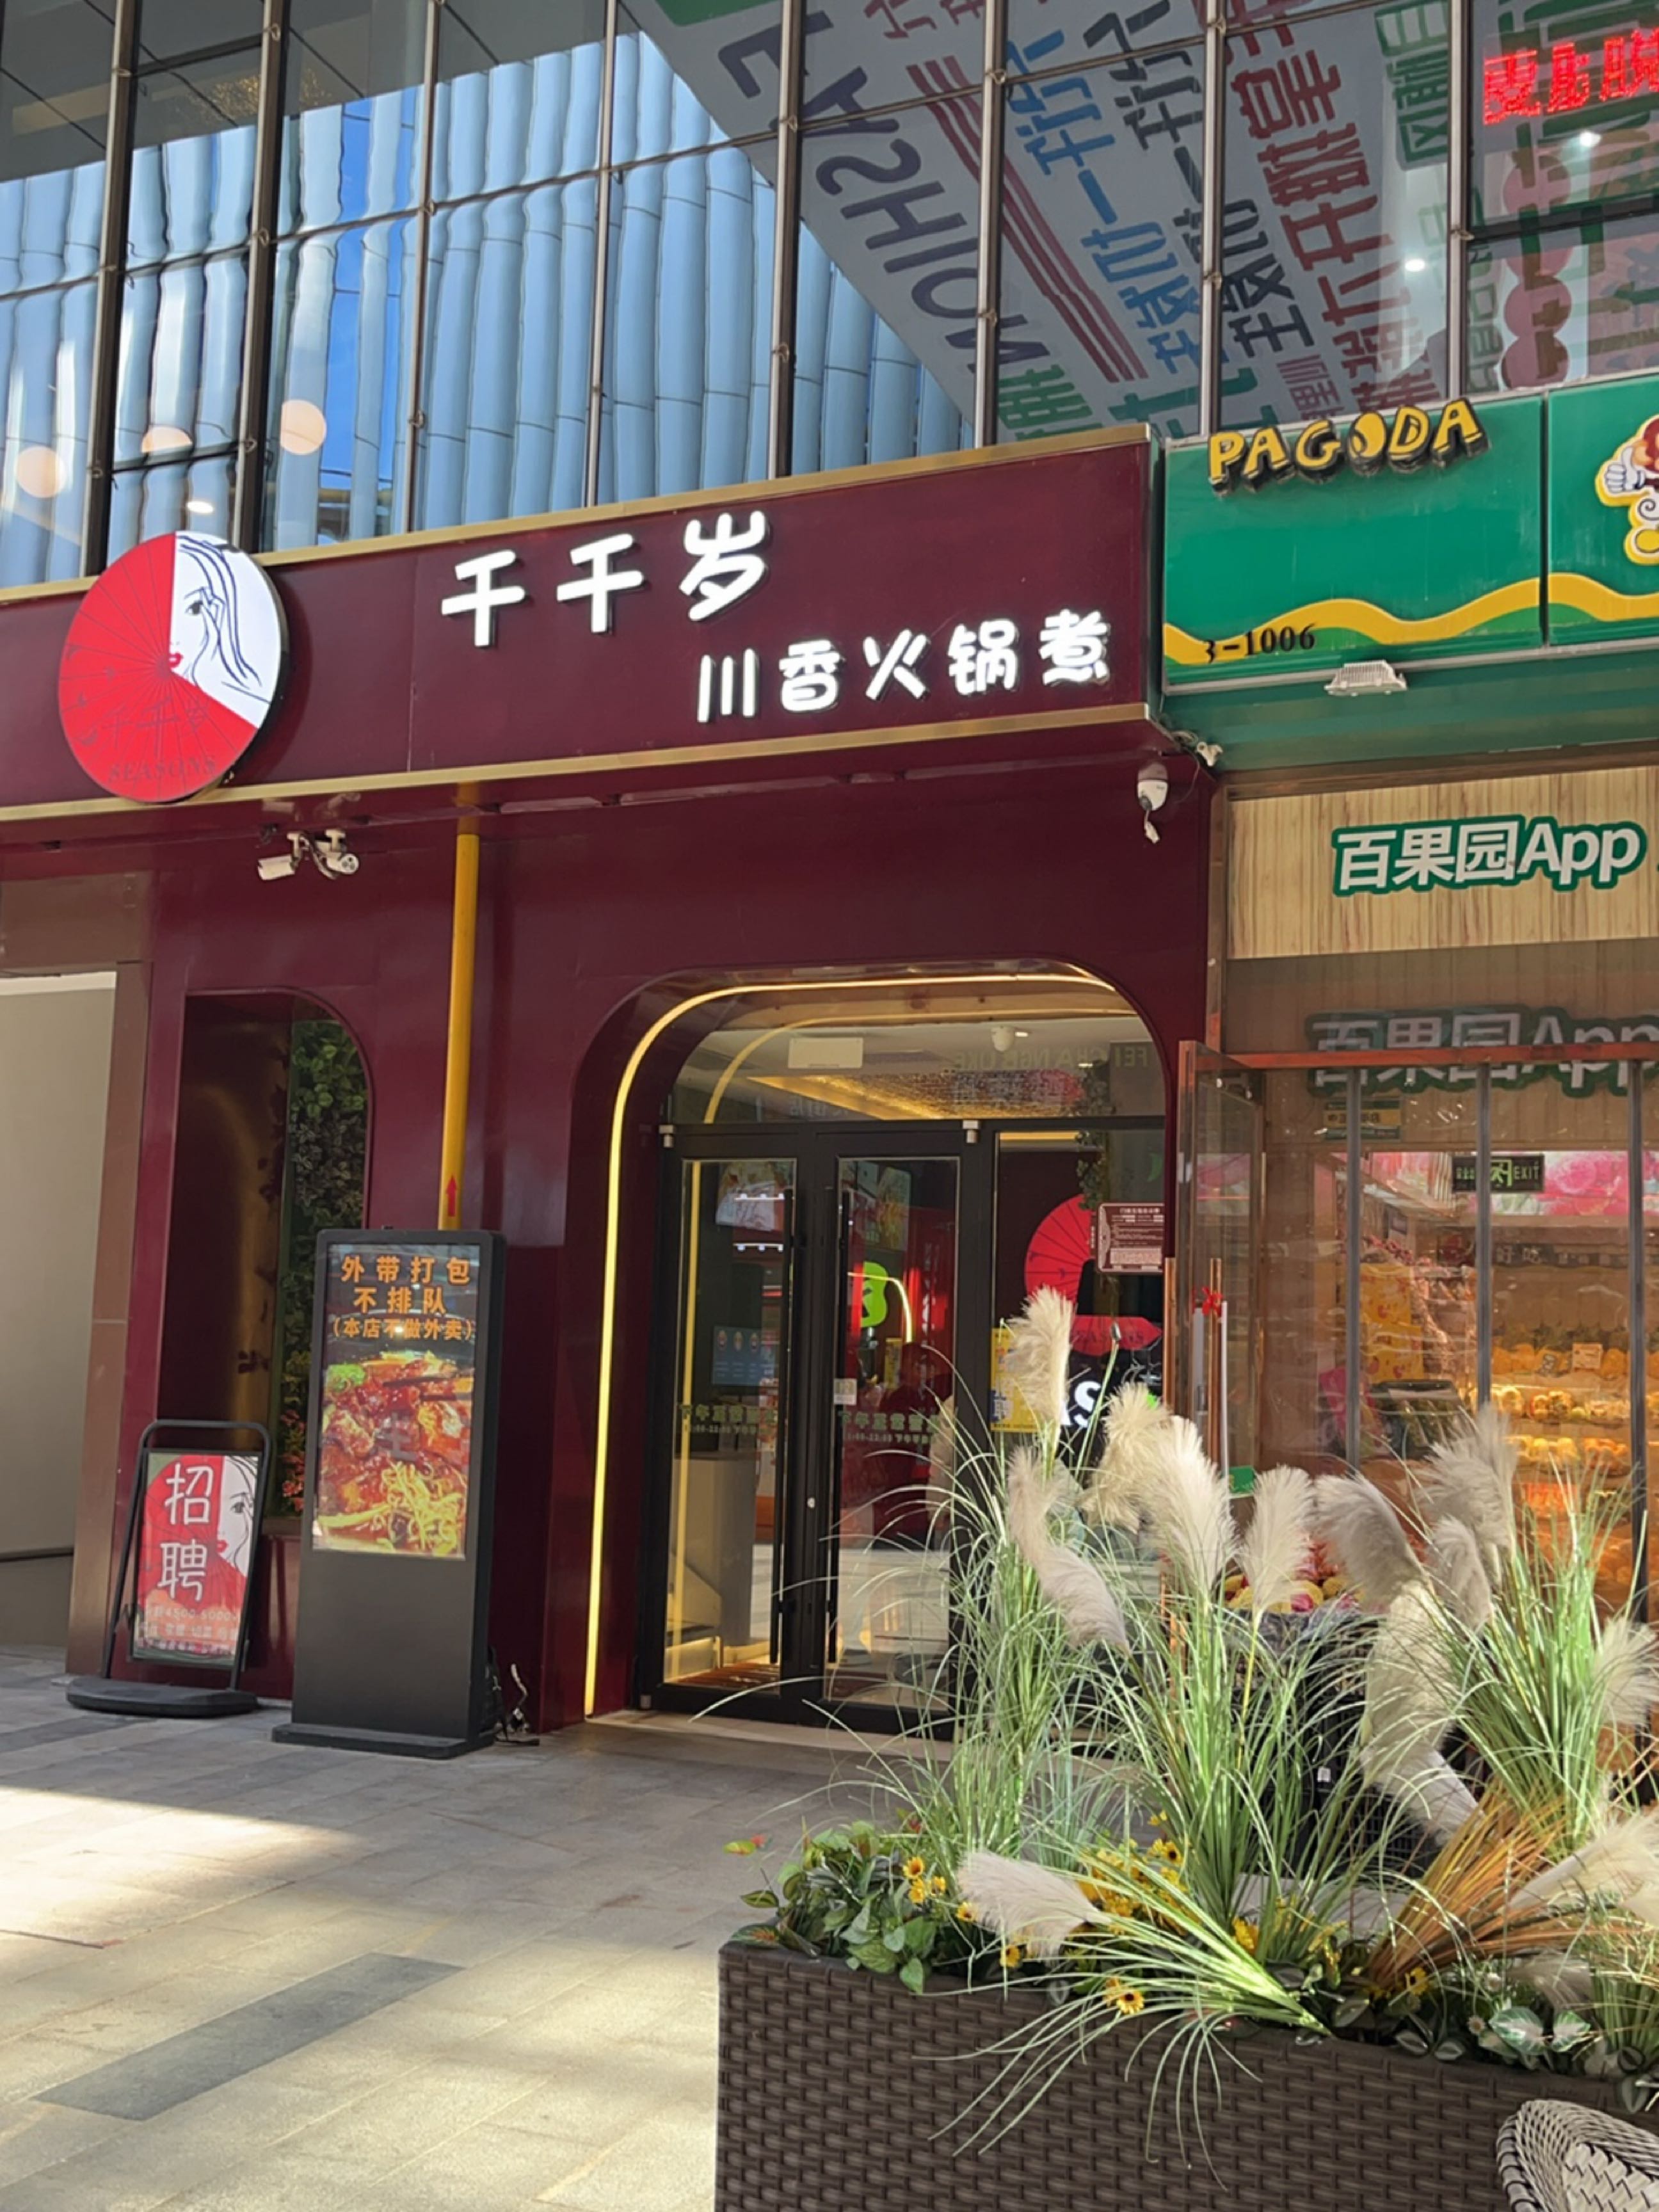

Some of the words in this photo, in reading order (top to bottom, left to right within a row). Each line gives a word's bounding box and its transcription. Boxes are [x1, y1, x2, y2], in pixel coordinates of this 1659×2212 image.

[1208, 397, 1489, 494] PAGODA
[440, 509, 768, 648] 千千岁
[696, 609, 1112, 724] 川香火锅煮
[1334, 817, 1645, 894] 百果园App
[1514, 1162, 1540, 1180] EXIT
[340, 1255, 471, 1285] 外带打包
[353, 1286, 447, 1314] 不排队
[157, 1462, 214, 1601] 招聘
